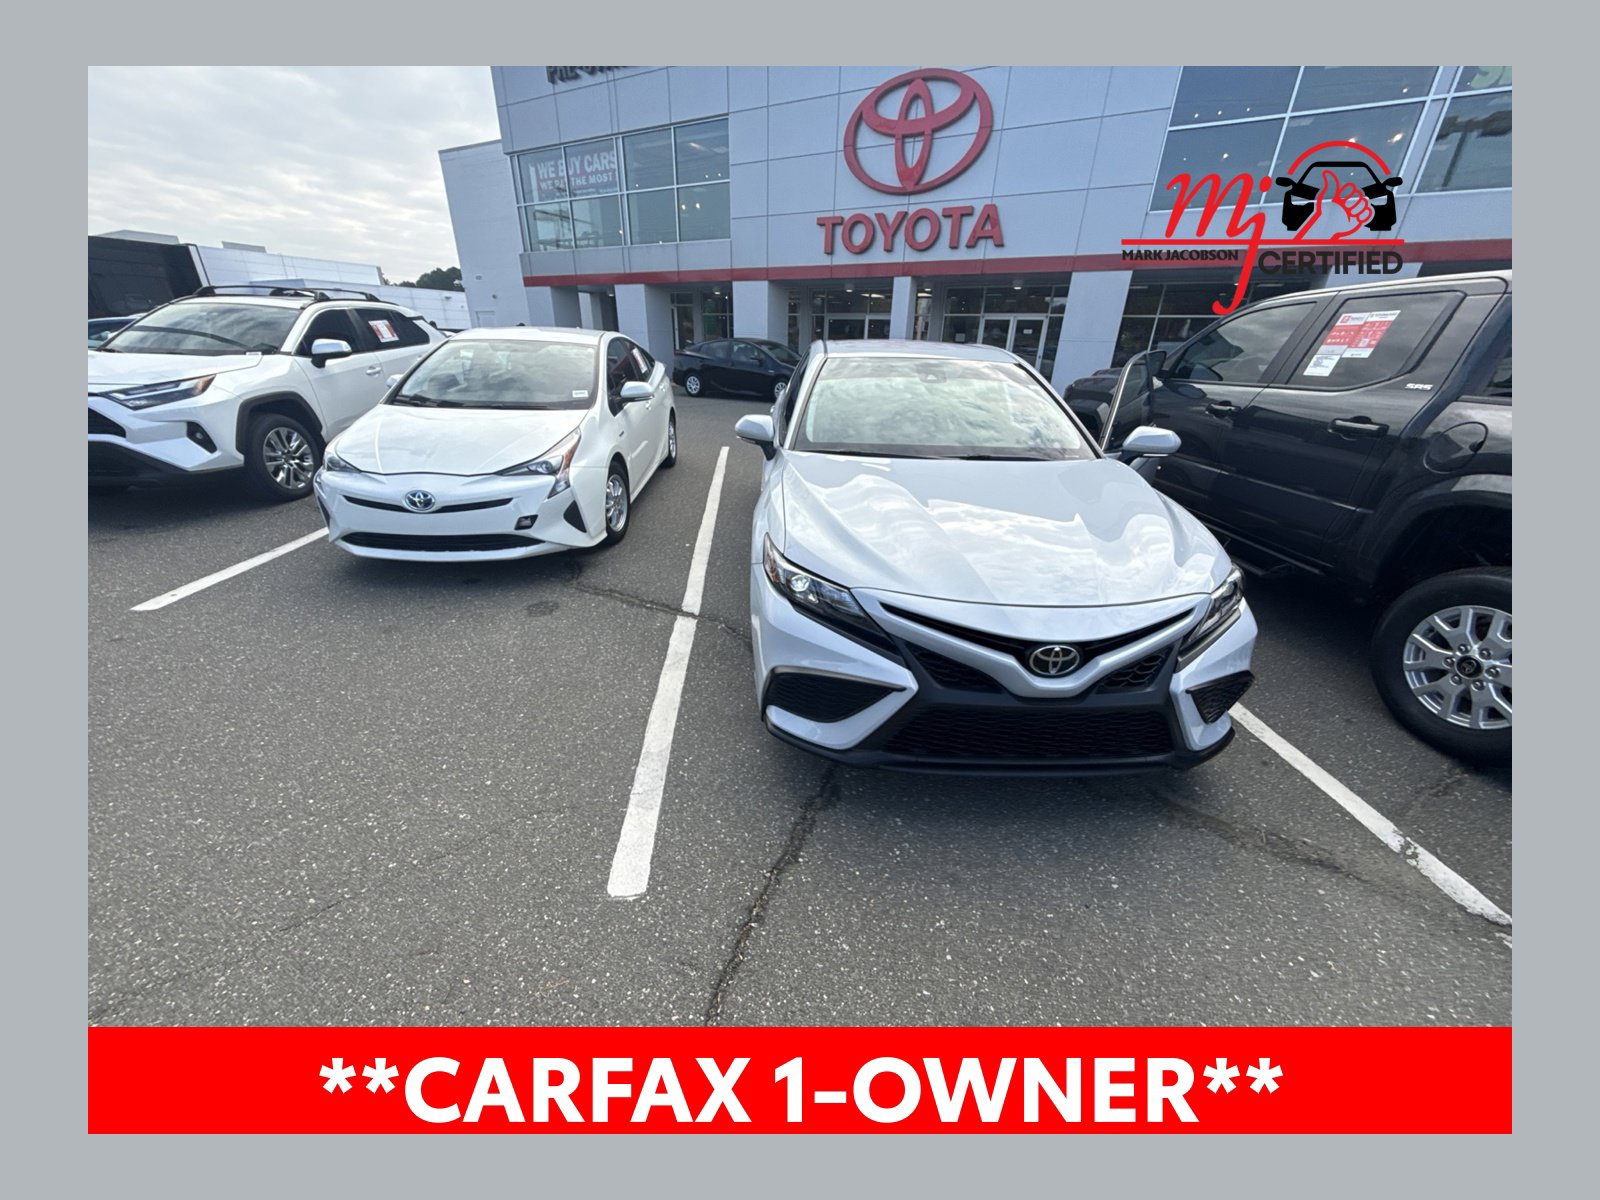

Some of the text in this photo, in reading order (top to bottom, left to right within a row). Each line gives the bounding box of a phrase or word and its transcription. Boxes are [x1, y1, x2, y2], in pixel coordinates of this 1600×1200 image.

[537, 151, 616, 179] WE BUY CARS
[570, 175, 587, 187] THE
[588, 173, 613, 185] MOST
[816, 203, 1005, 255] TOYOTA
